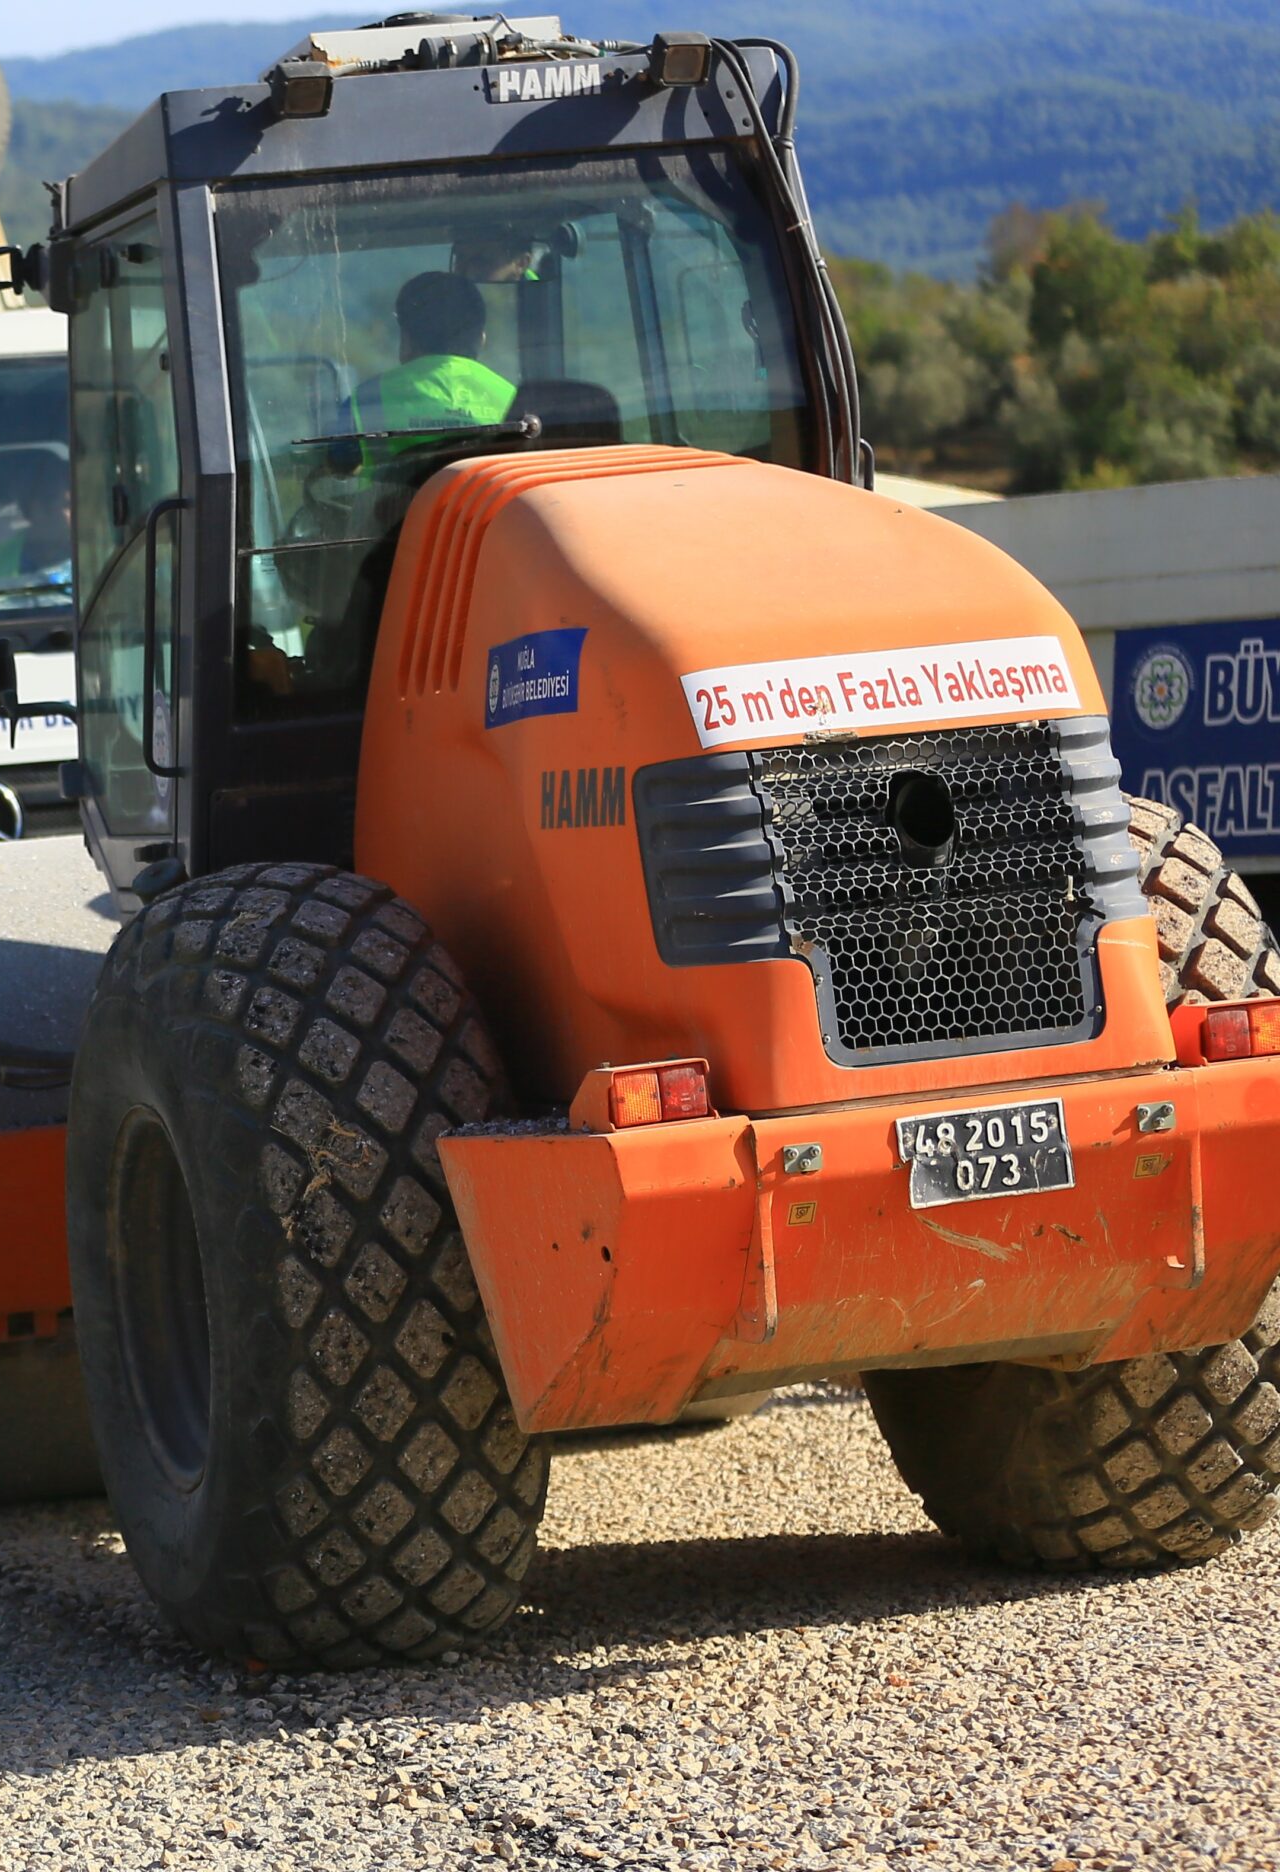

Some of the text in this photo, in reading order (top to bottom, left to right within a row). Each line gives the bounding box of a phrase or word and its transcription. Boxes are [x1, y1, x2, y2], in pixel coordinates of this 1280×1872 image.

[499, 64, 601, 102] HAMM
[696, 659, 1068, 731] 25 m'den Fazla Yaklaşma
[541, 766, 625, 829] HAMM
[915, 1110, 1049, 1157] 48 2015
[956, 1153, 1021, 1191] 073
